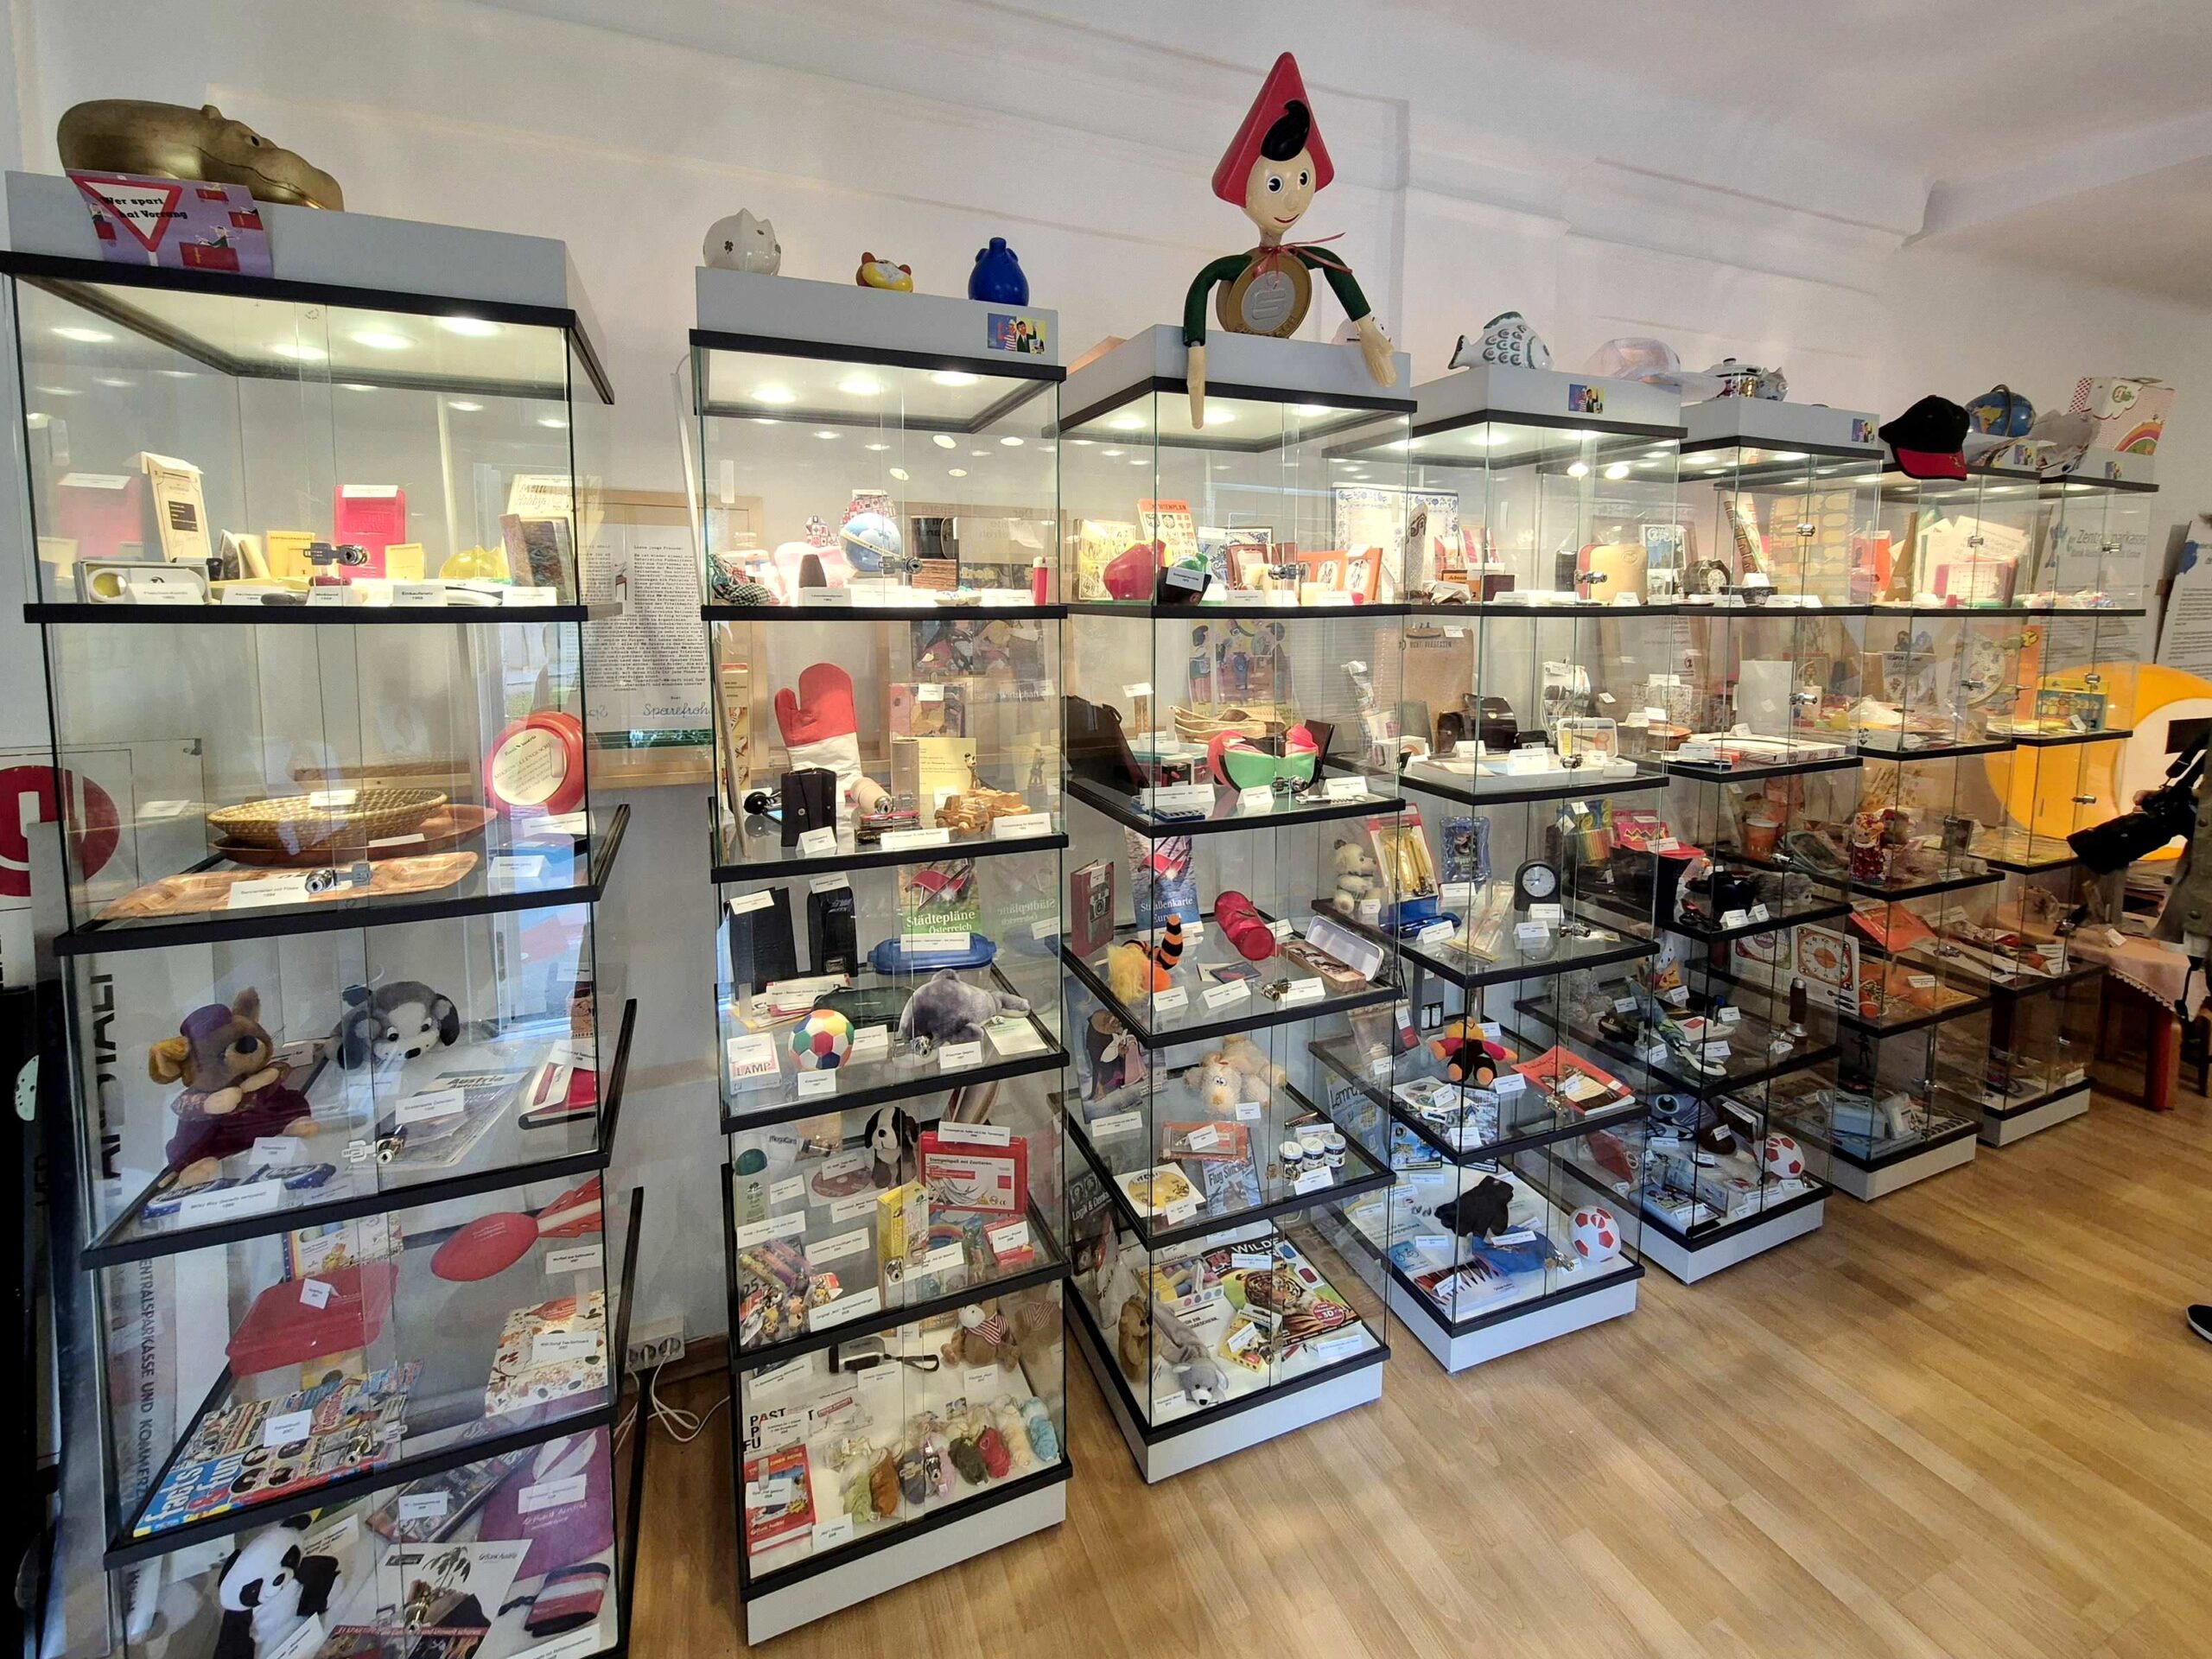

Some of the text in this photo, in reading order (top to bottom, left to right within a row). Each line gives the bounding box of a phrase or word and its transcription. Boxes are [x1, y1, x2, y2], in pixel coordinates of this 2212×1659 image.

[102, 197, 163, 206] Wer spart
[120, 210, 188, 219] hat Vorrang
[643, 702, 710, 719] Sparefroh
[906, 910, 976, 928] Städtepläne
[1153, 912, 1182, 924] Eura
[929, 922, 973, 933] Österreich
[1209, 1171, 1224, 1186] Flug
[1321, 1309, 1335, 1319] 3D
[134, 1258, 156, 1502] ENTRALSPARKASSE UND KOMMERZ
[749, 1408, 786, 1426] PAST
